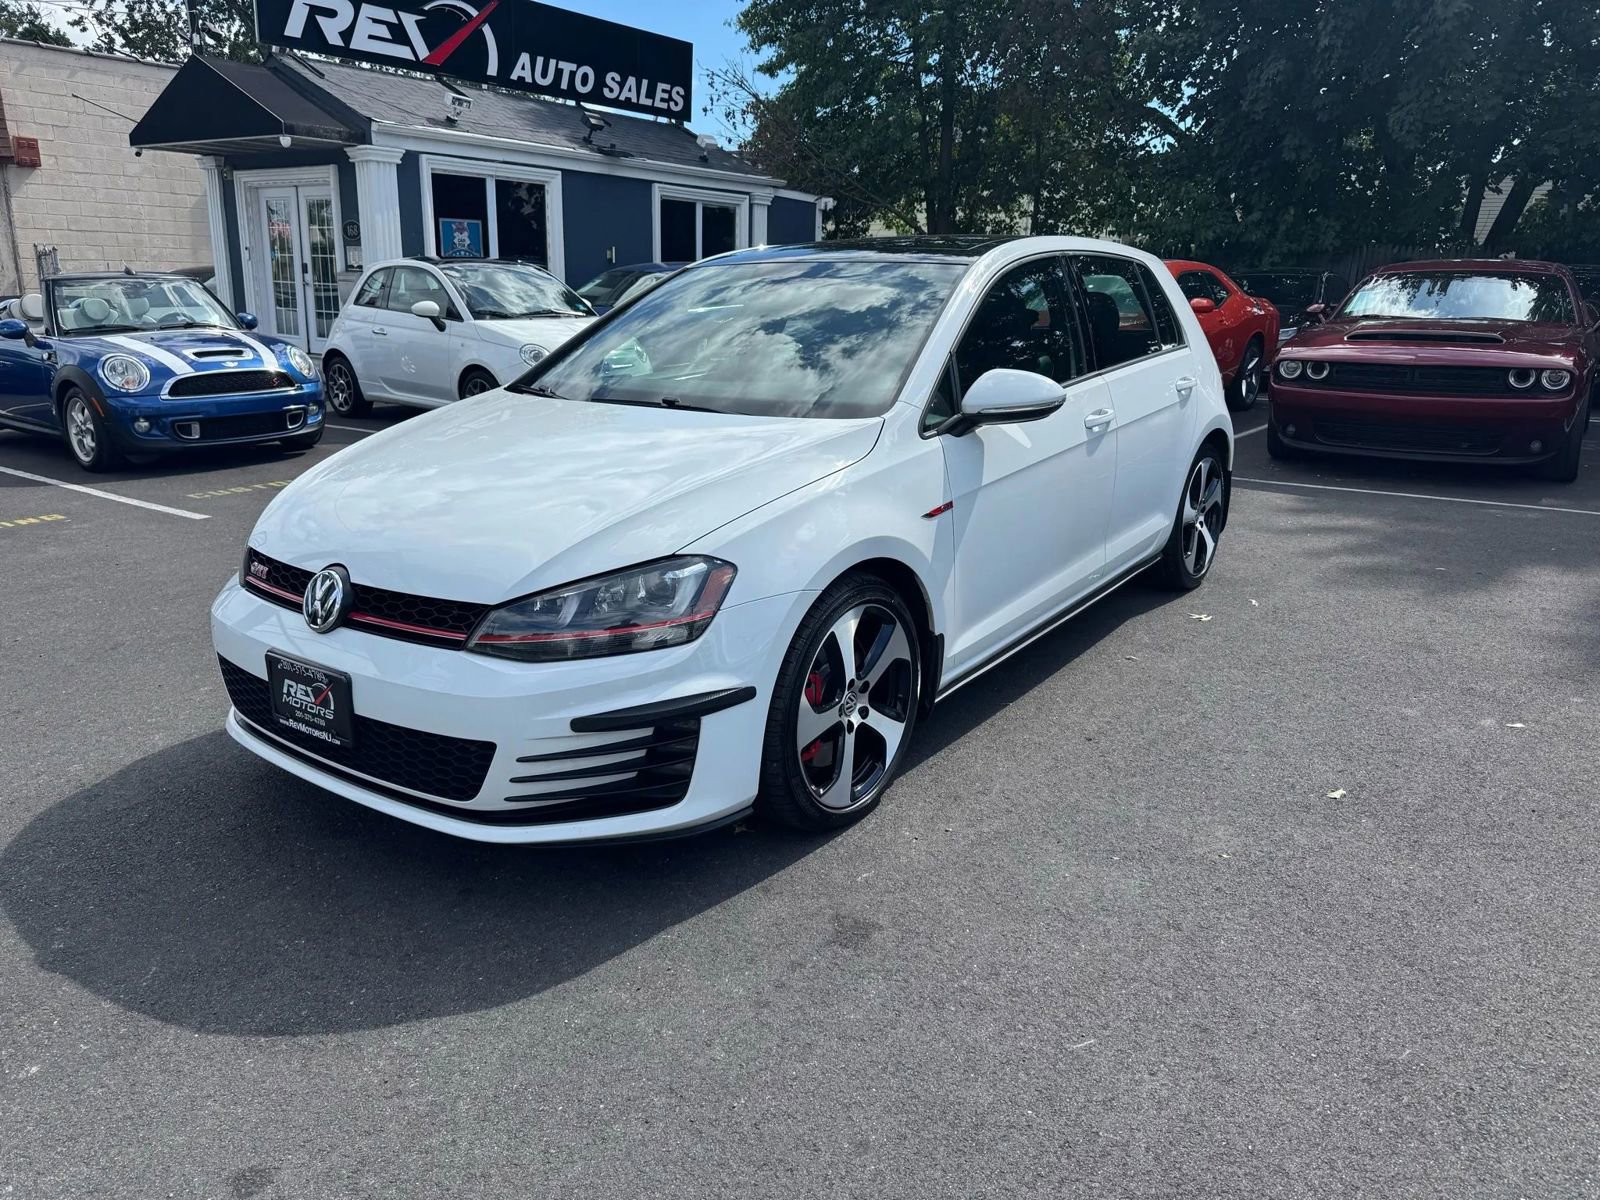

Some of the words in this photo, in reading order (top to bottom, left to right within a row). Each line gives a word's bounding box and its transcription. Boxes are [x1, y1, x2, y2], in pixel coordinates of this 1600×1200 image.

[510, 51, 595, 94] AUTO
[602, 71, 685, 112] SALES
[283, 678, 334, 706] REV
[282, 694, 334, 719] MOTORS
